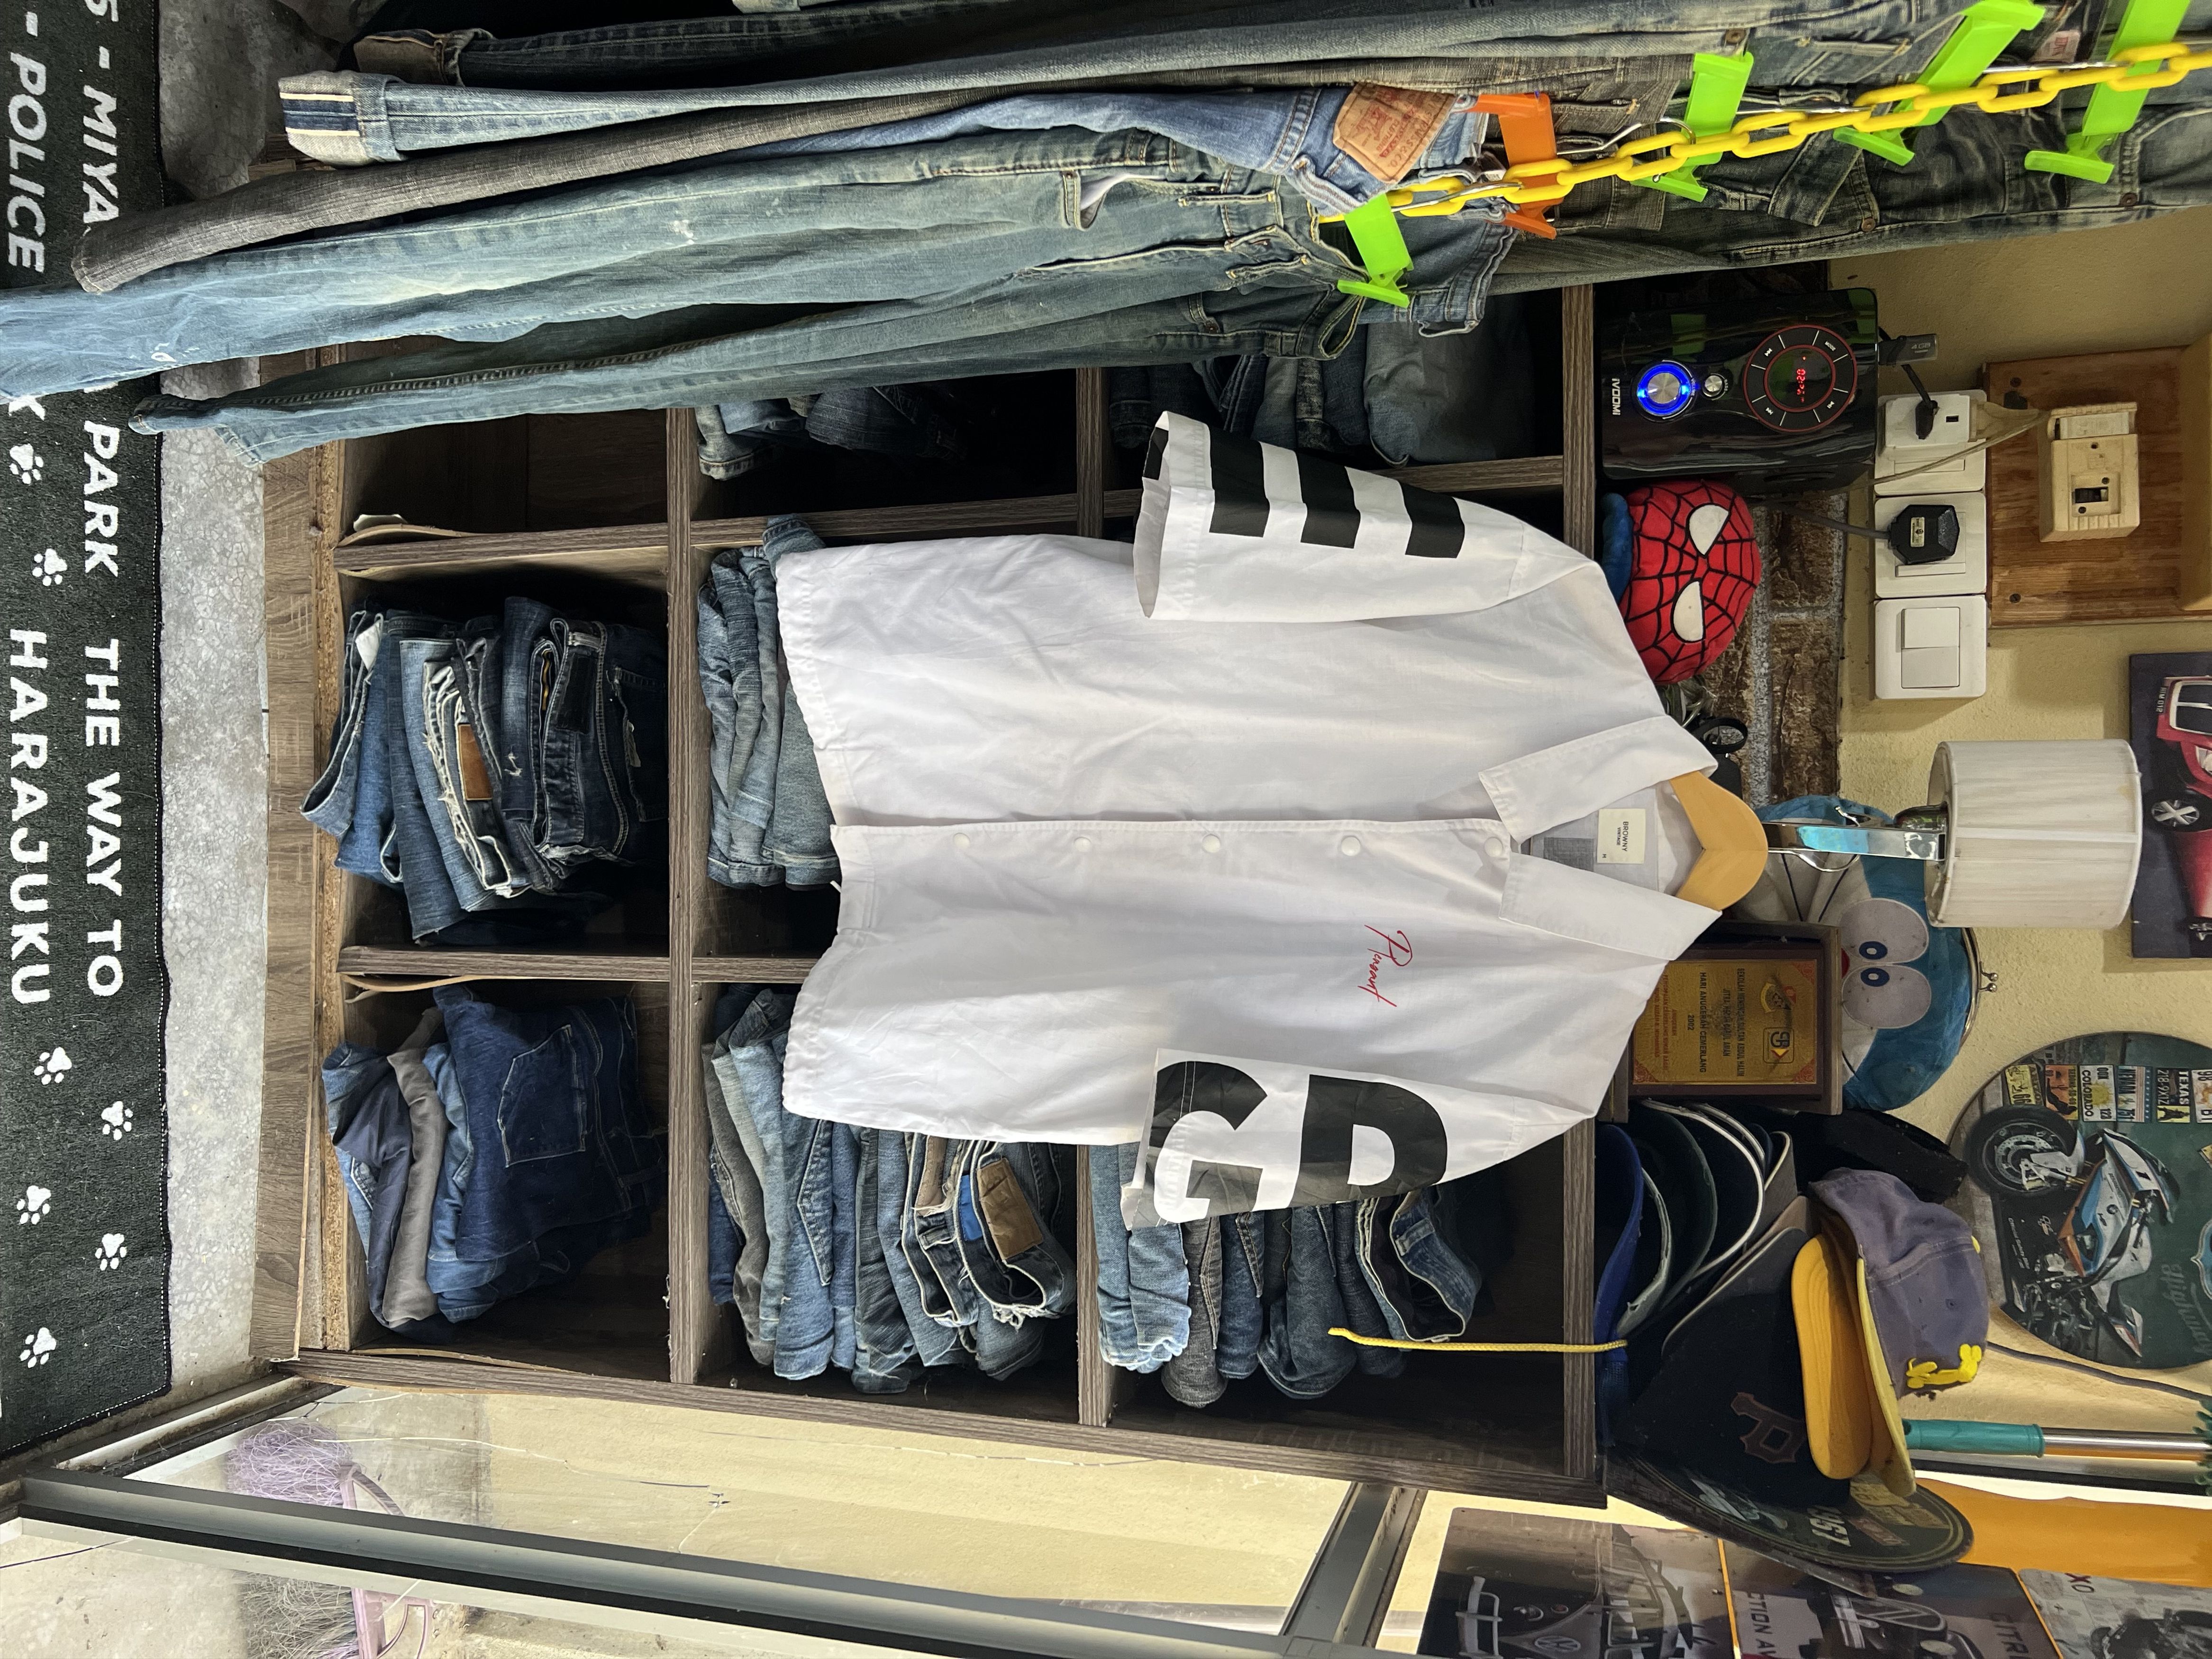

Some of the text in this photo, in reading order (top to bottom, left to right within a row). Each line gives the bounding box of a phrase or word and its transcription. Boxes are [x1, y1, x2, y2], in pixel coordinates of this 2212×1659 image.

[7, 52, 47, 273] POLICE
[83, 420, 120, 577] PARK
[9, 629, 50, 1004] HARAJUKU
[85, 638, 124, 997] THE WAY TO
[1357, 924, 1413, 1007] Pleasant
[1737, 1043, 1745, 1059] ABDUL
[2118, 1069, 2136, 1094] NEVADA
[2082, 1070, 2094, 1117] COLORADO
[2179, 1071, 2189, 1104] TEXAS
[1987, 1613, 2030, 1659] CITR
